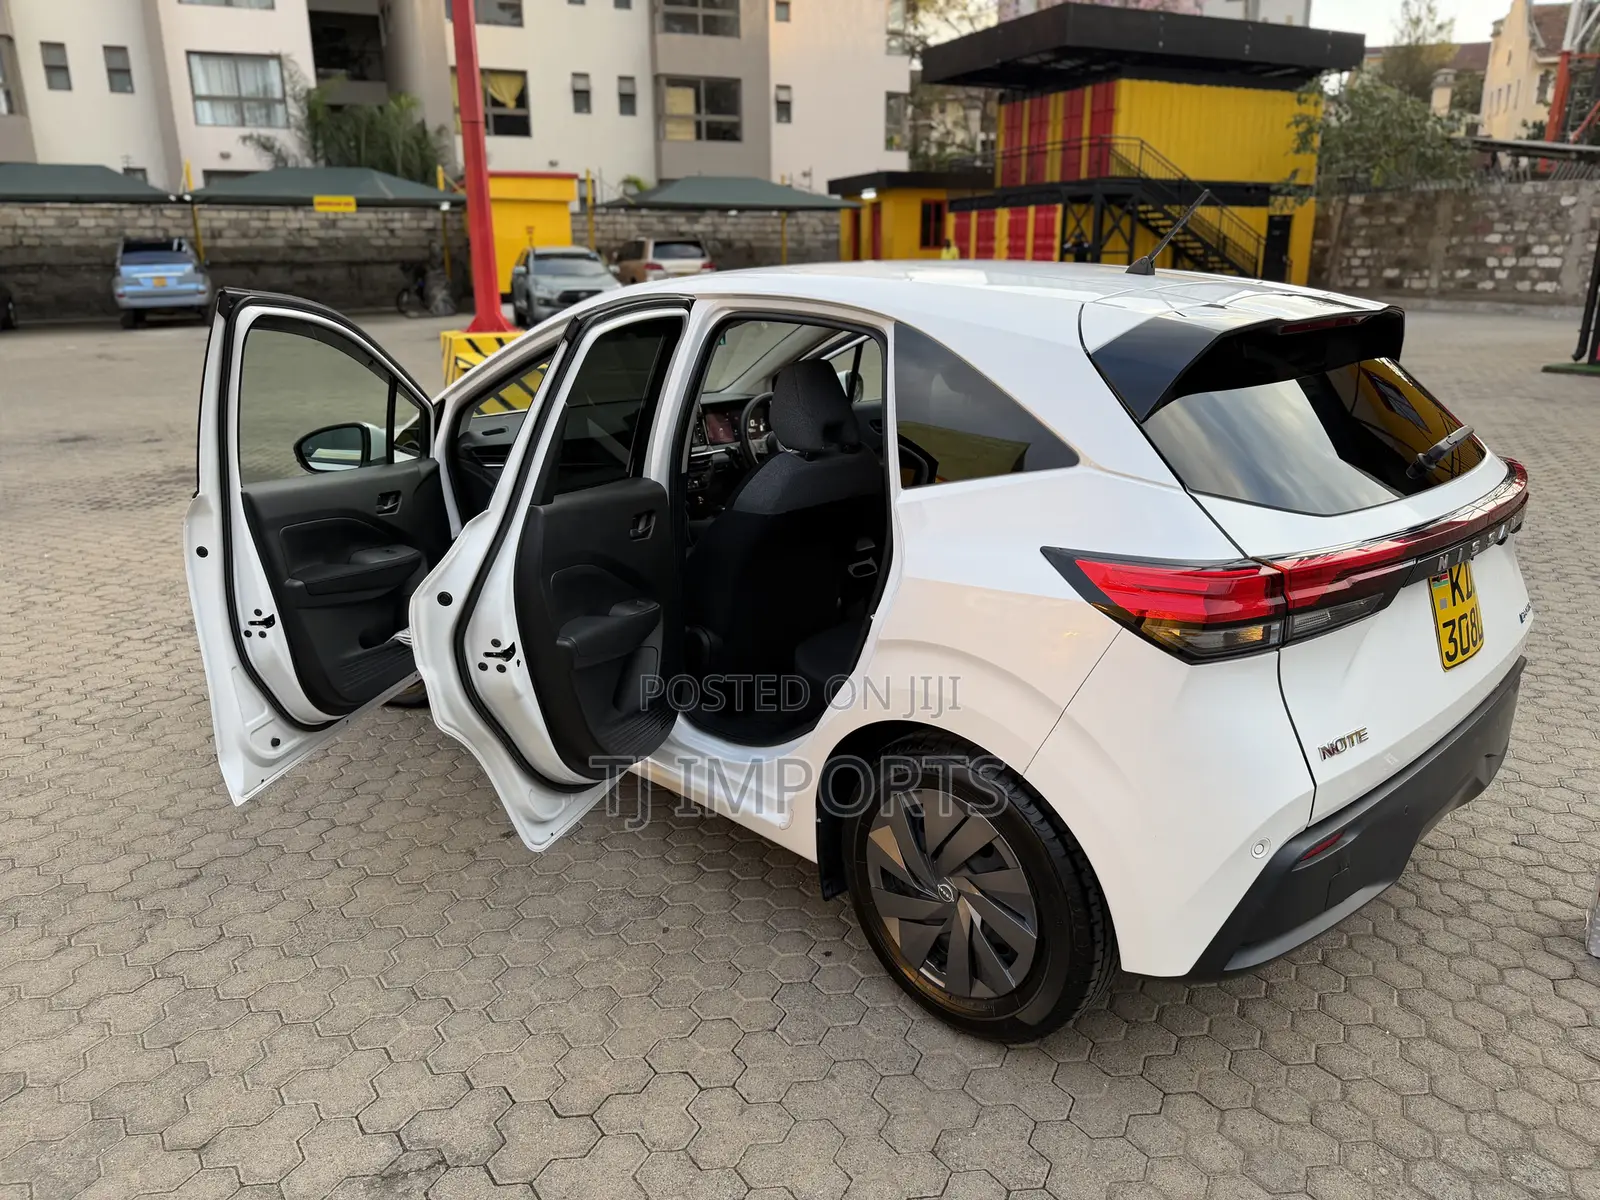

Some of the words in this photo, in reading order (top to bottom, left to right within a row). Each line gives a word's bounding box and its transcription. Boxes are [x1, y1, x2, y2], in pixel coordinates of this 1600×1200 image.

[1437, 515, 1518, 572] NISSAN
[1448, 561, 1476, 607] KD
[1317, 726, 1370, 762] NOTE
